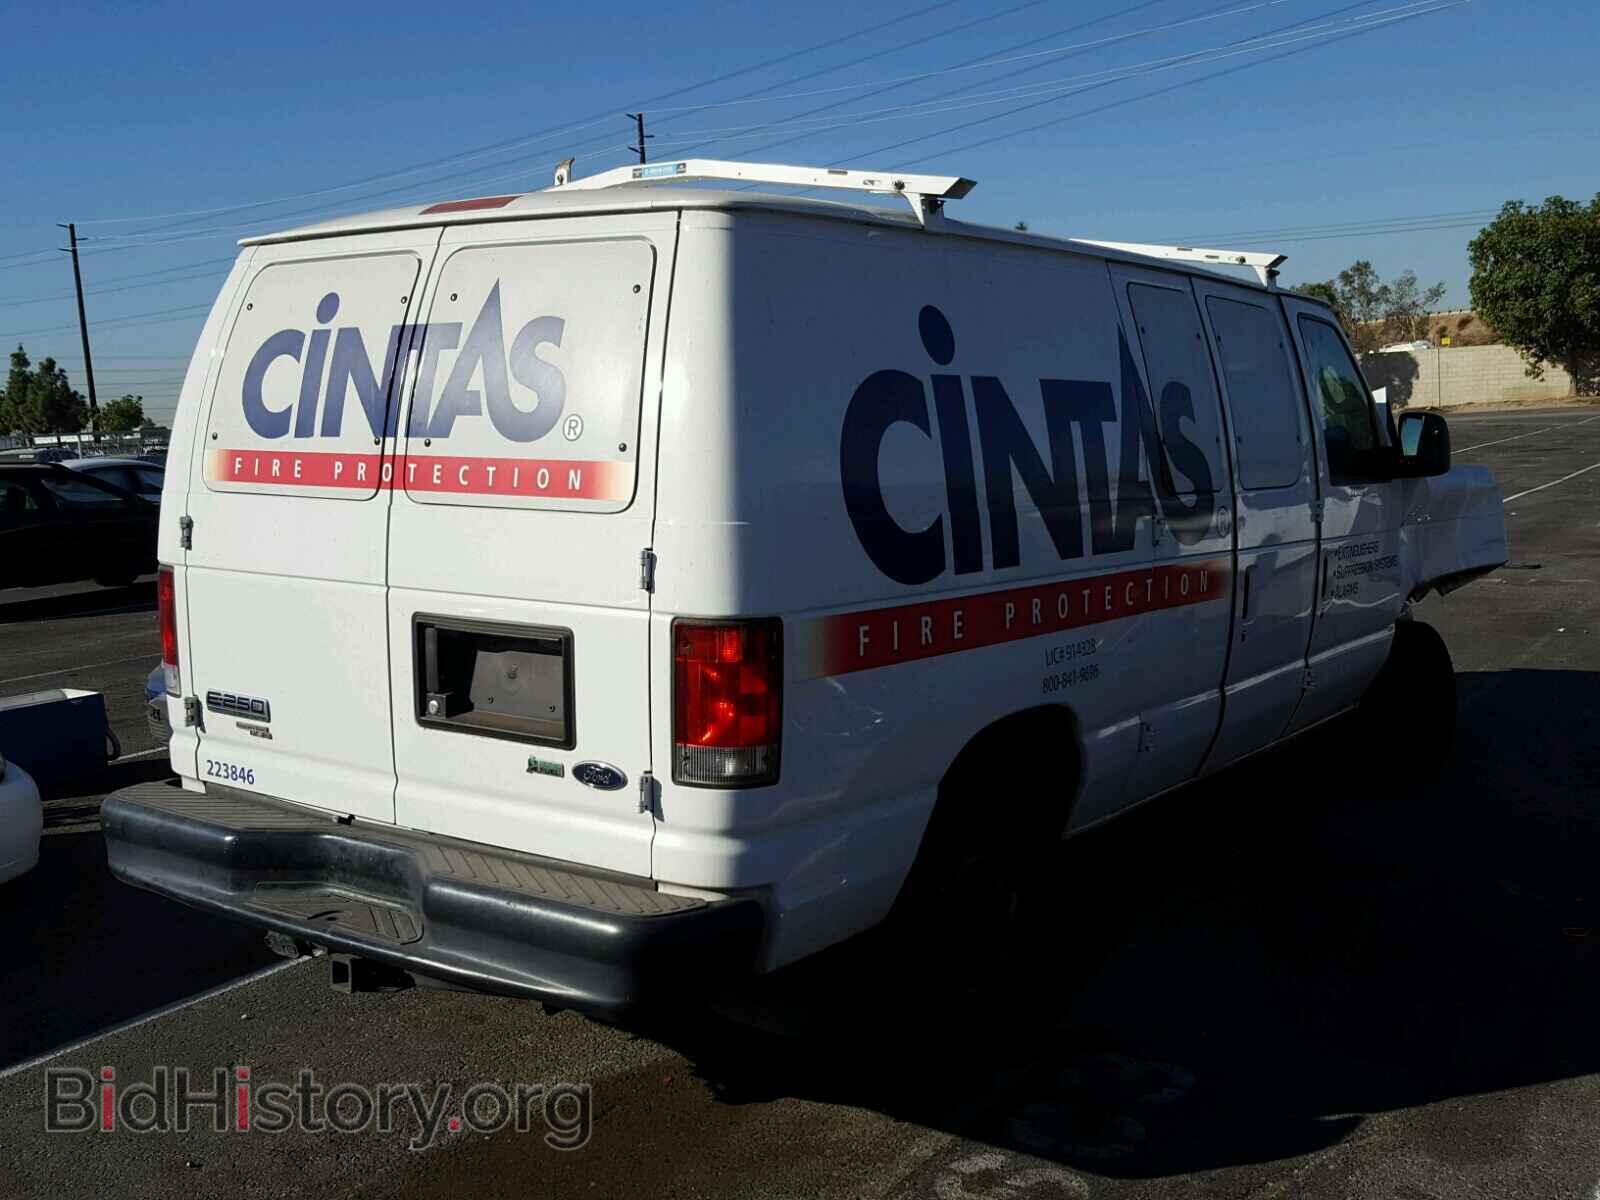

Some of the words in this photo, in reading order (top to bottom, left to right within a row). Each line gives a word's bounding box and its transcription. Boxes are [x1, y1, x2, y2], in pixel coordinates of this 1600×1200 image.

[234, 456, 302, 478] FIRE
[333, 460, 582, 490] PROTECTION
[858, 610, 964, 658] FIRE
[1005, 568, 1209, 630] PROTECTION
[207, 759, 255, 785] 223846
